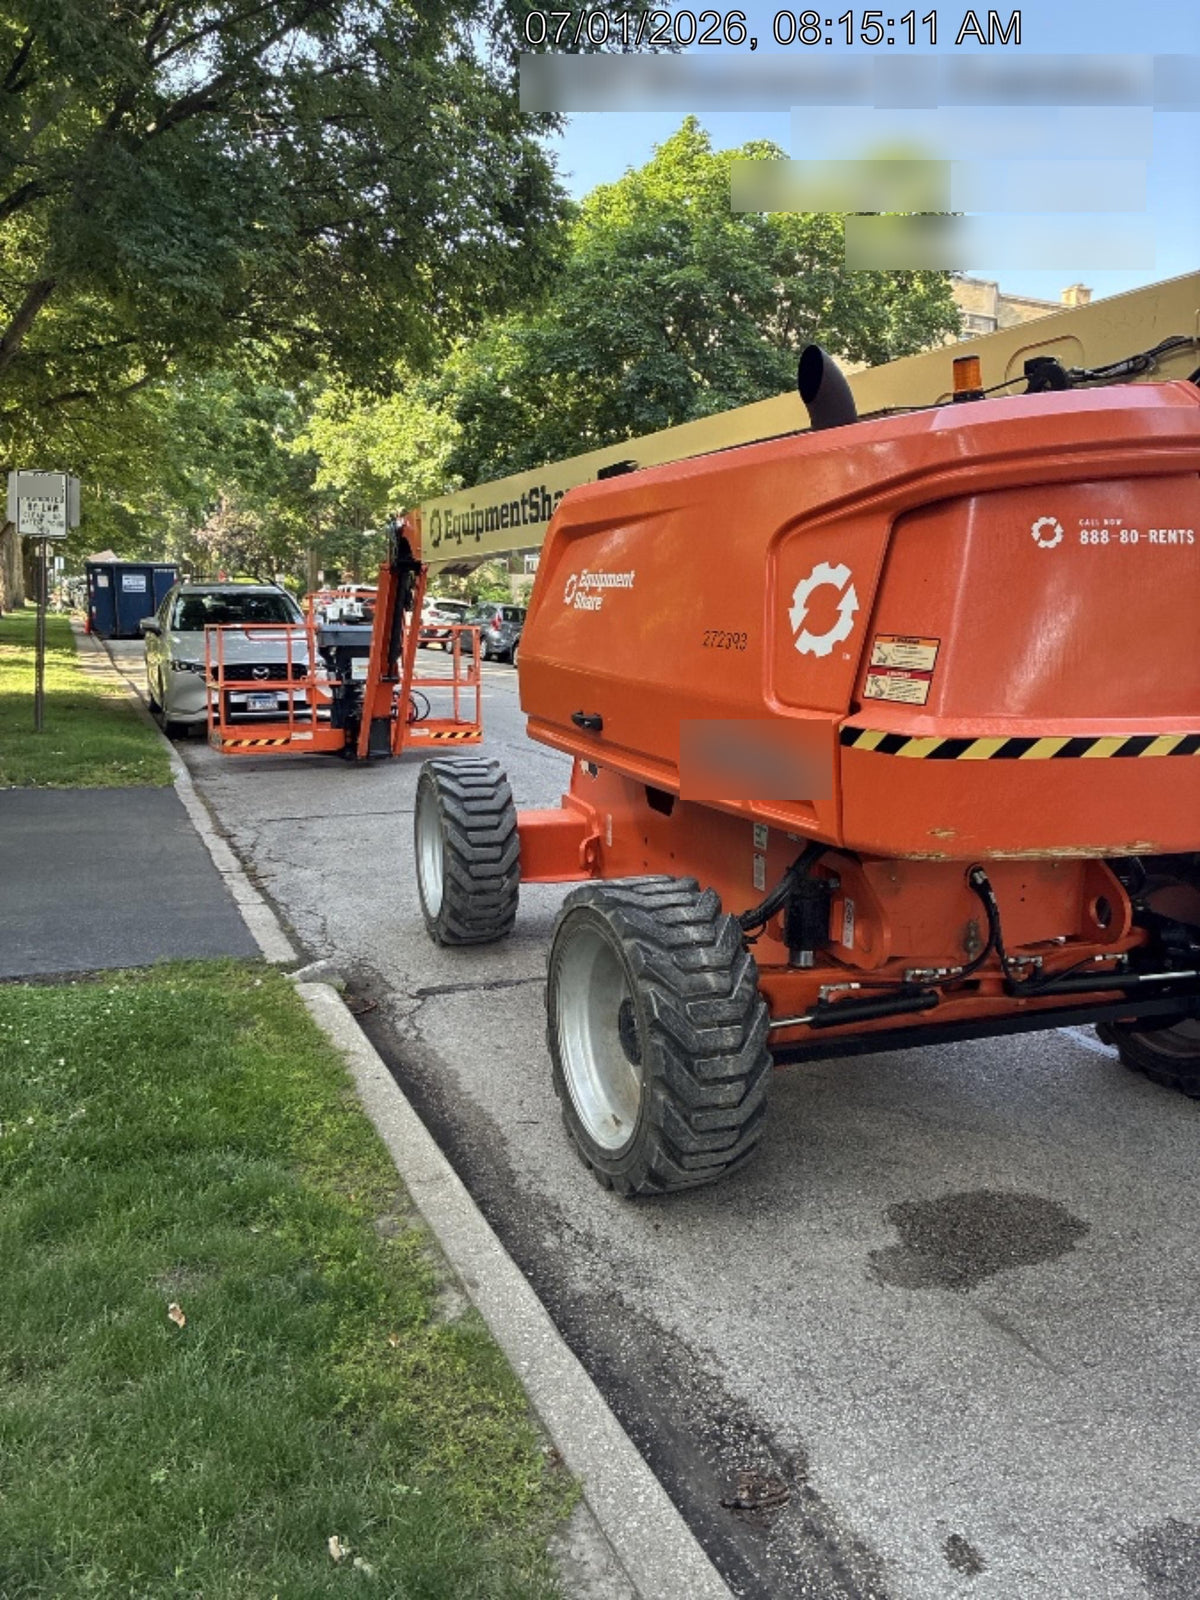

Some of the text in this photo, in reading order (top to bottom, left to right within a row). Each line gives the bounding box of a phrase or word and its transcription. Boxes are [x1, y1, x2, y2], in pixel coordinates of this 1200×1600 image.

[444, 484, 568, 545] EquipmentSha
[1103, 518, 1123, 526] NOW
[1080, 528, 1195, 545] 888-80-RENTS
[578, 568, 636, 593] Equipment
[573, 591, 604, 611] Share
